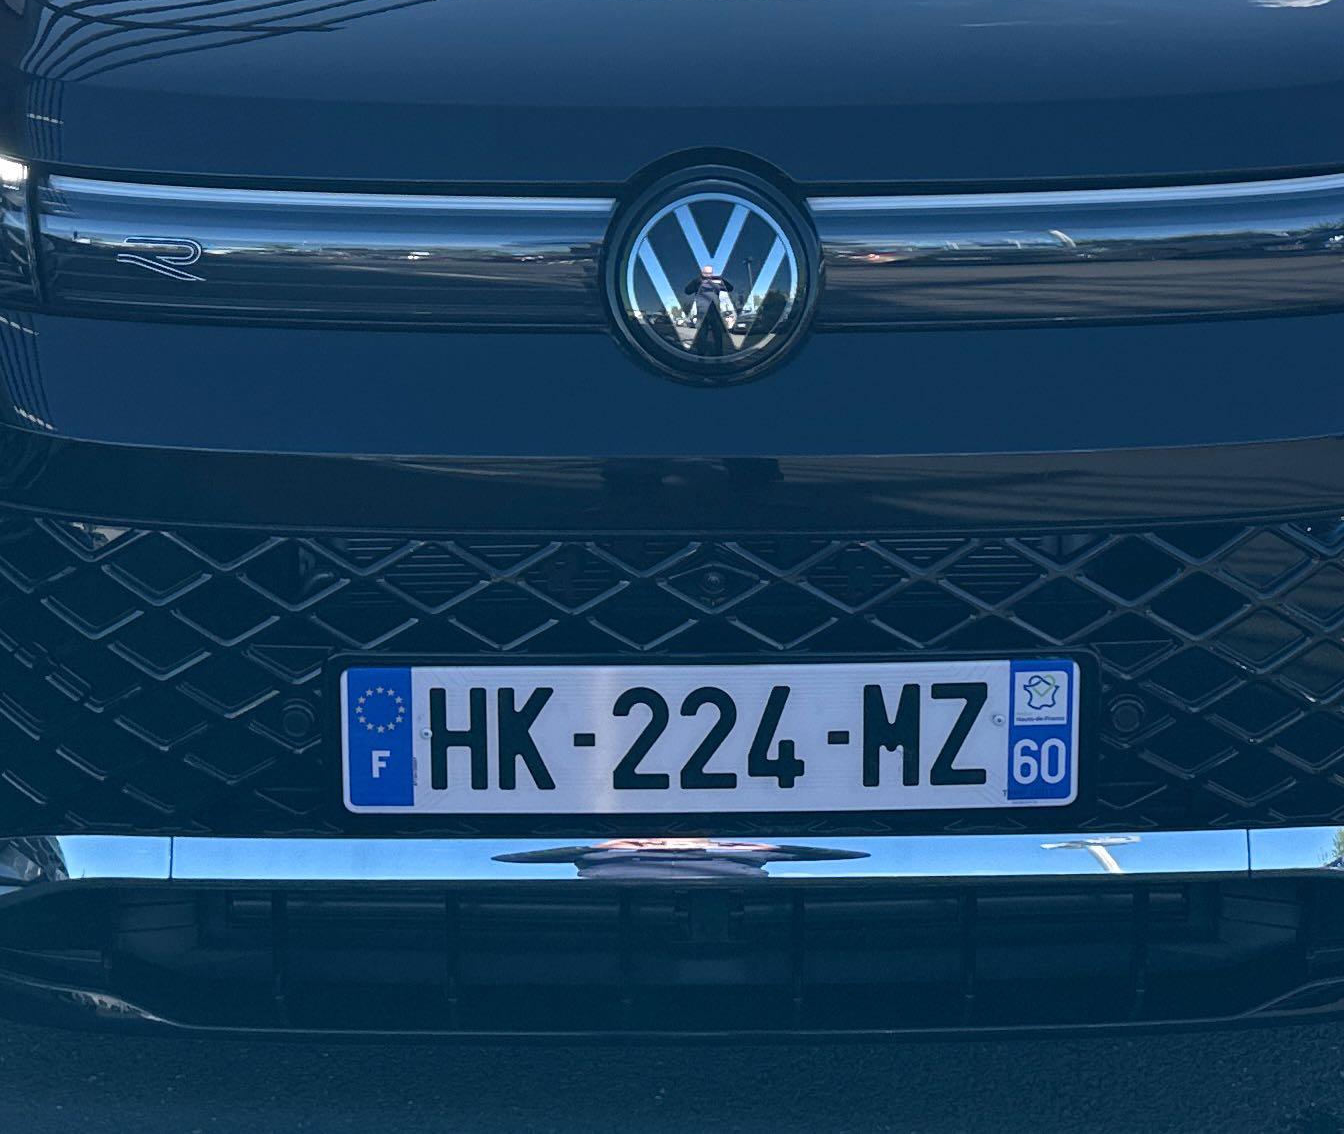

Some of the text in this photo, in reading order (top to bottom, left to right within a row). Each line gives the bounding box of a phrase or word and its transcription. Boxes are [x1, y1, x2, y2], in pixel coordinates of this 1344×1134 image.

[429, 682, 988, 791] HK-224-MZ
[371, 750, 391, 778] F
[1013, 737, 1067, 785] 60
